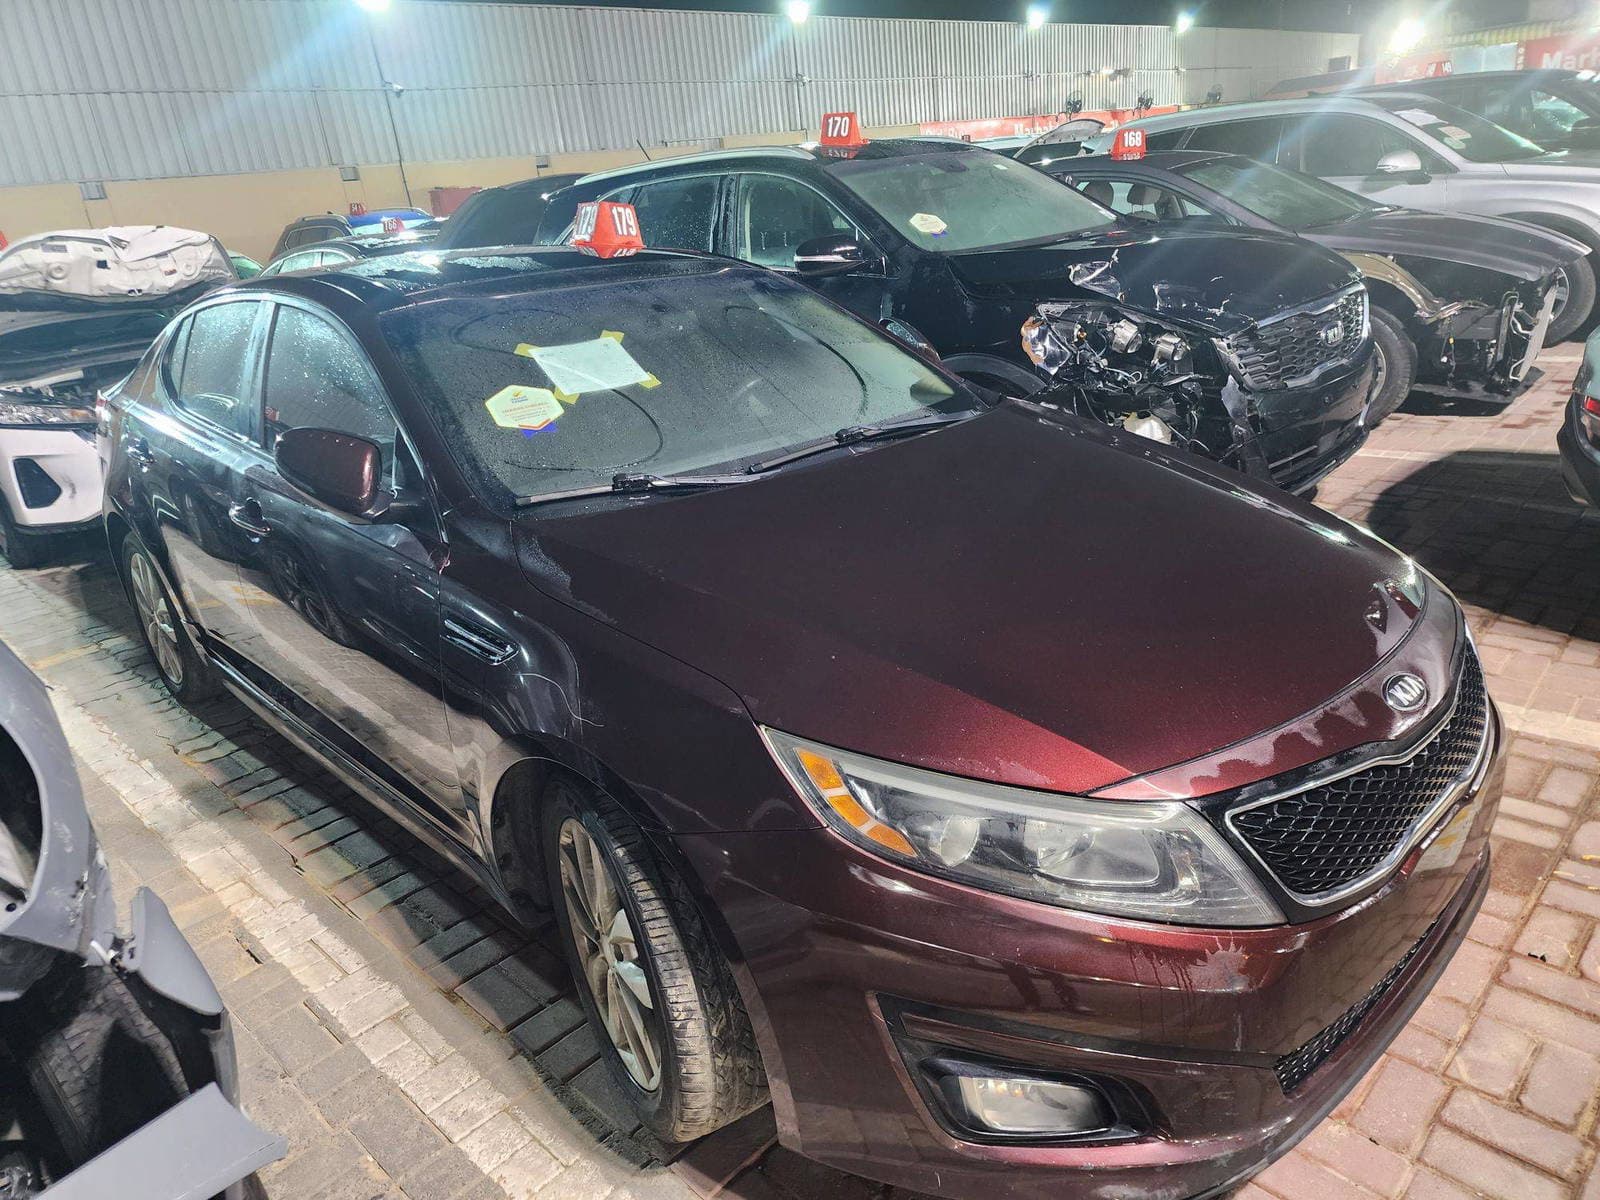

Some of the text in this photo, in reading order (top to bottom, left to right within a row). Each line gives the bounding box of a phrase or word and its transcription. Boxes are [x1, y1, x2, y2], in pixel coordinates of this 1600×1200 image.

[827, 116, 850, 138] 170
[1123, 131, 1142, 148] 168
[611, 205, 637, 236] 179
[1388, 676, 1425, 706] KIA
